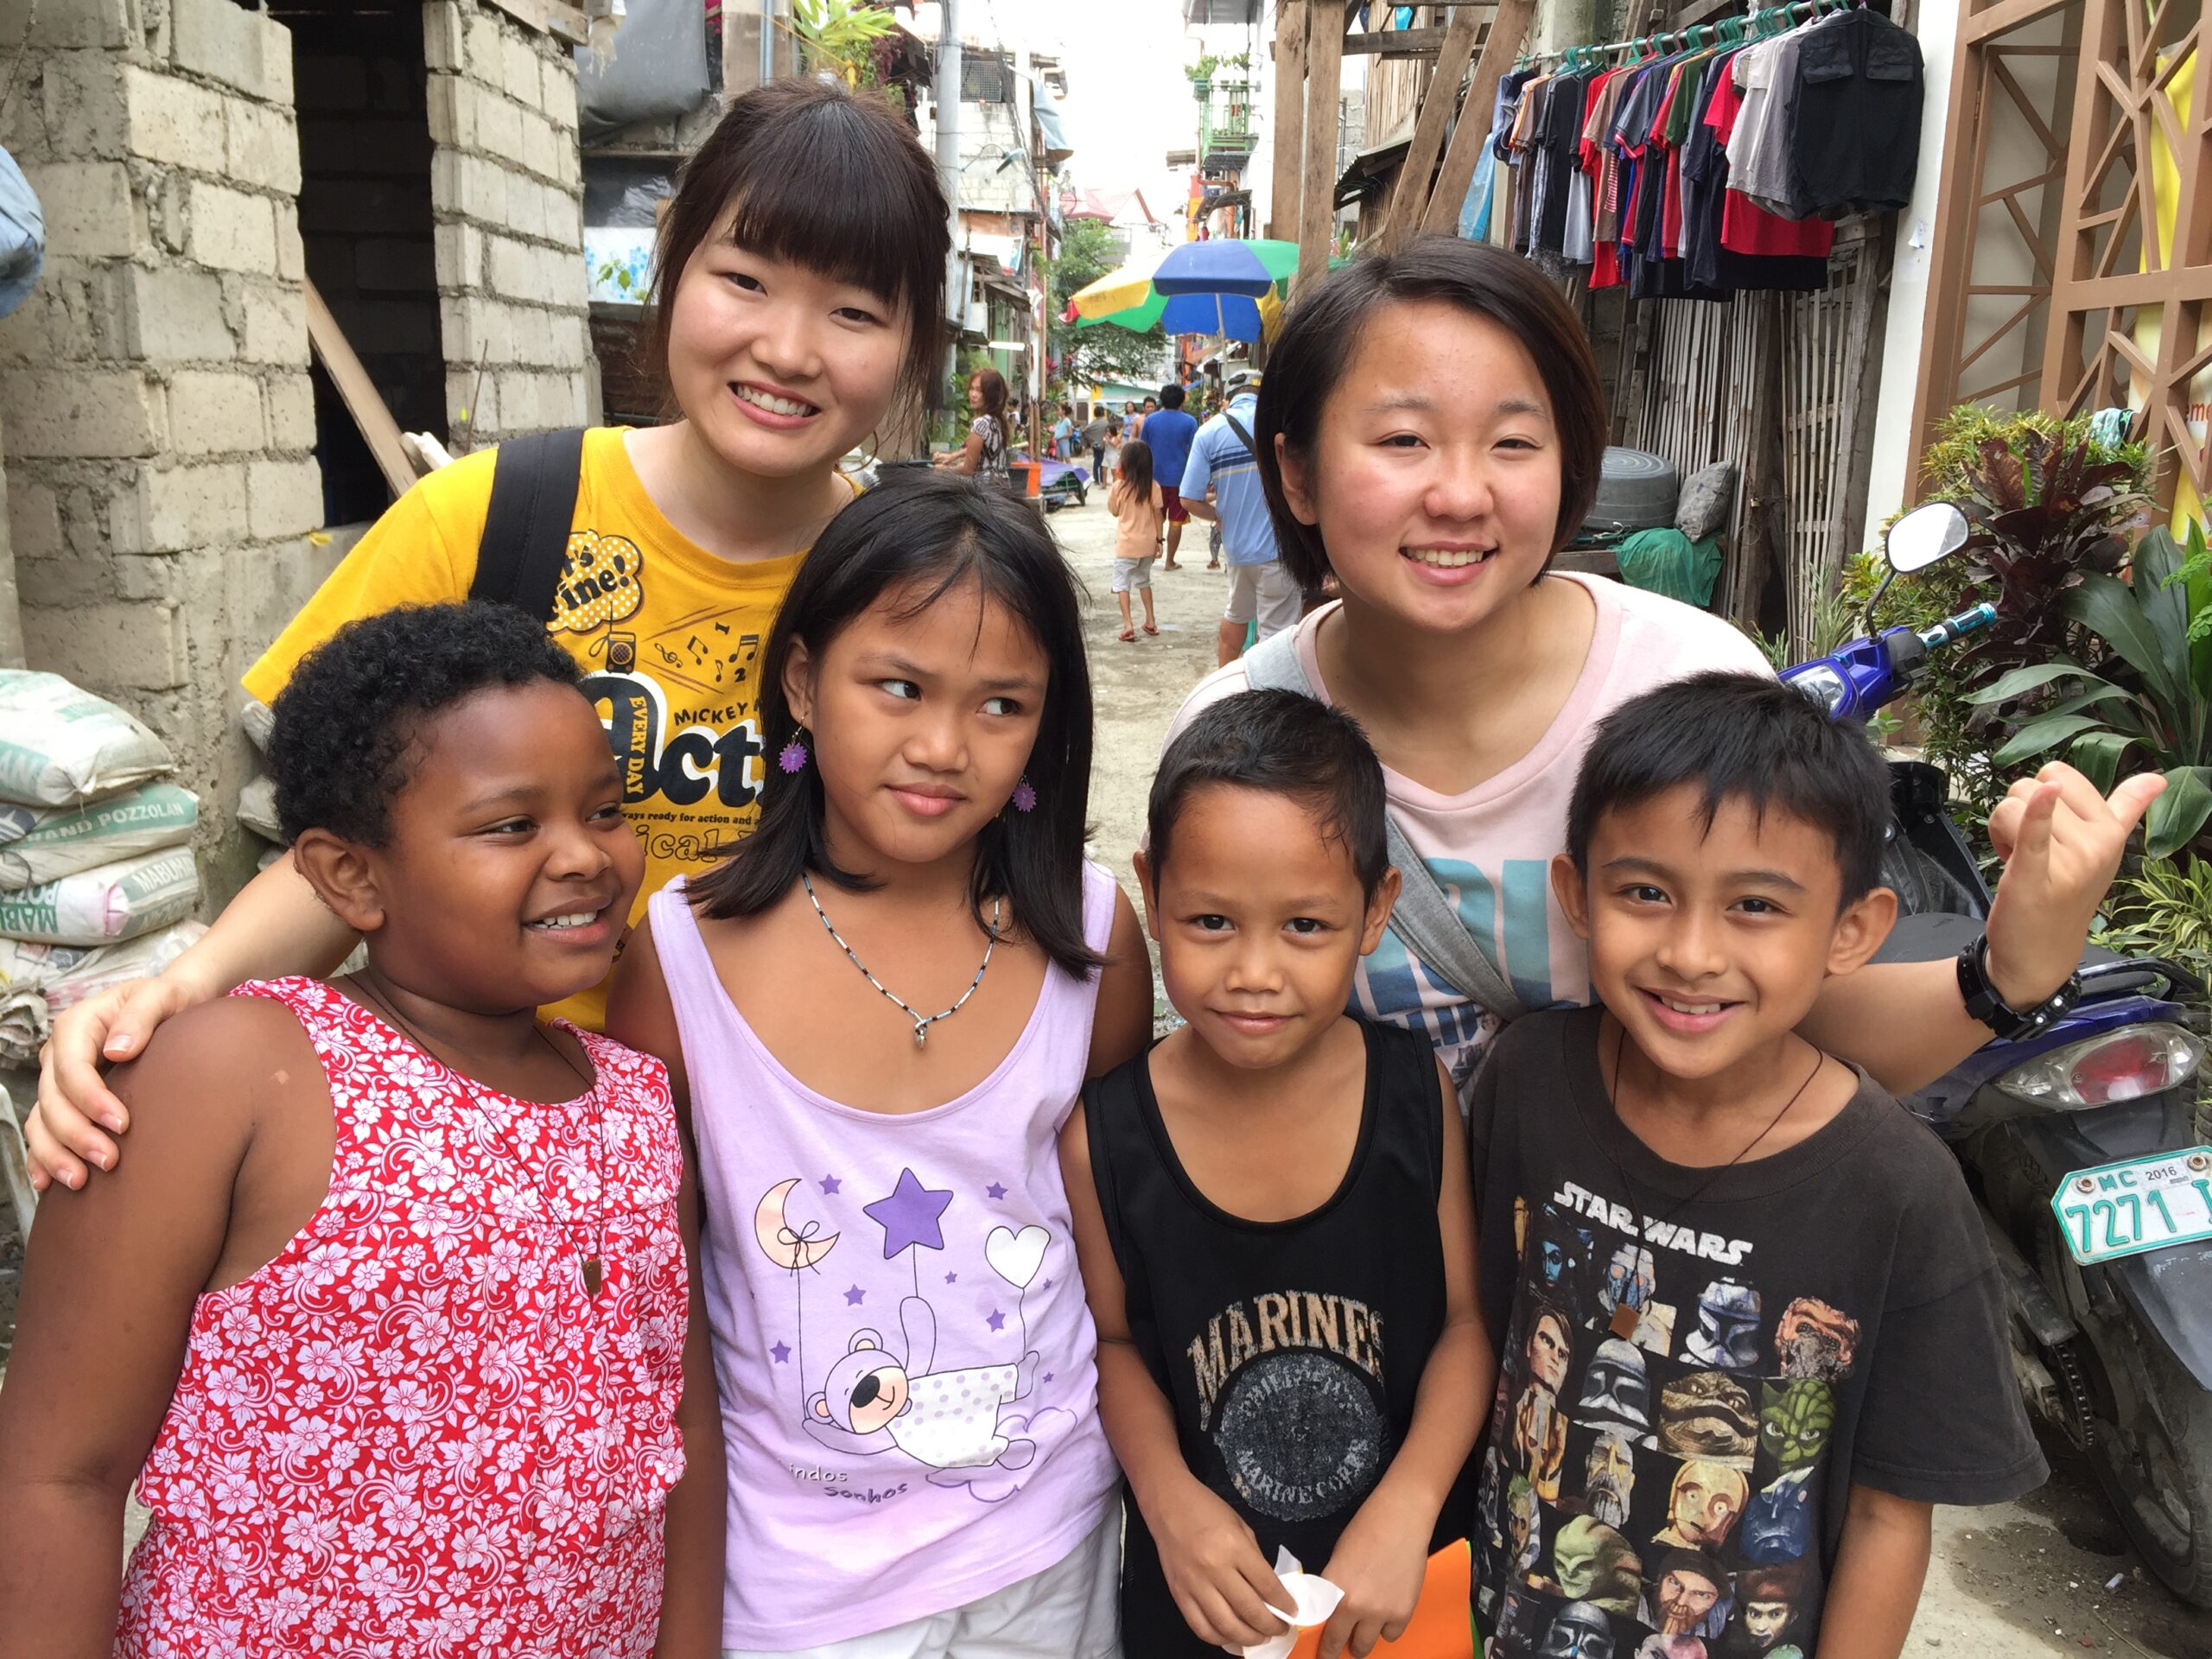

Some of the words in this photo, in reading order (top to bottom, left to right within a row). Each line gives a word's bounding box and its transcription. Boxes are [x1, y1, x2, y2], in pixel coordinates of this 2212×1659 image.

[554, 555, 630, 617] ine!
[734, 667, 747, 683] 2
[629, 696, 648, 753] EVERY
[674, 702, 748, 726] MICKEY
[626, 757, 645, 794] DAY
[97, 802, 185, 827] POZZOLAN
[647, 812, 677, 823] ready
[679, 812, 696, 822] for
[697, 814, 729, 823] action
[635, 823, 721, 862] ical
[2098, 1170, 2137, 1192] MC
[2145, 1166, 2177, 1181] 2016
[1553, 1180, 1639, 1237] STAR
[1643, 1215, 1753, 1266] WARS
[2065, 1189, 2177, 1253] 7271
[789, 1462, 849, 1482] indos
